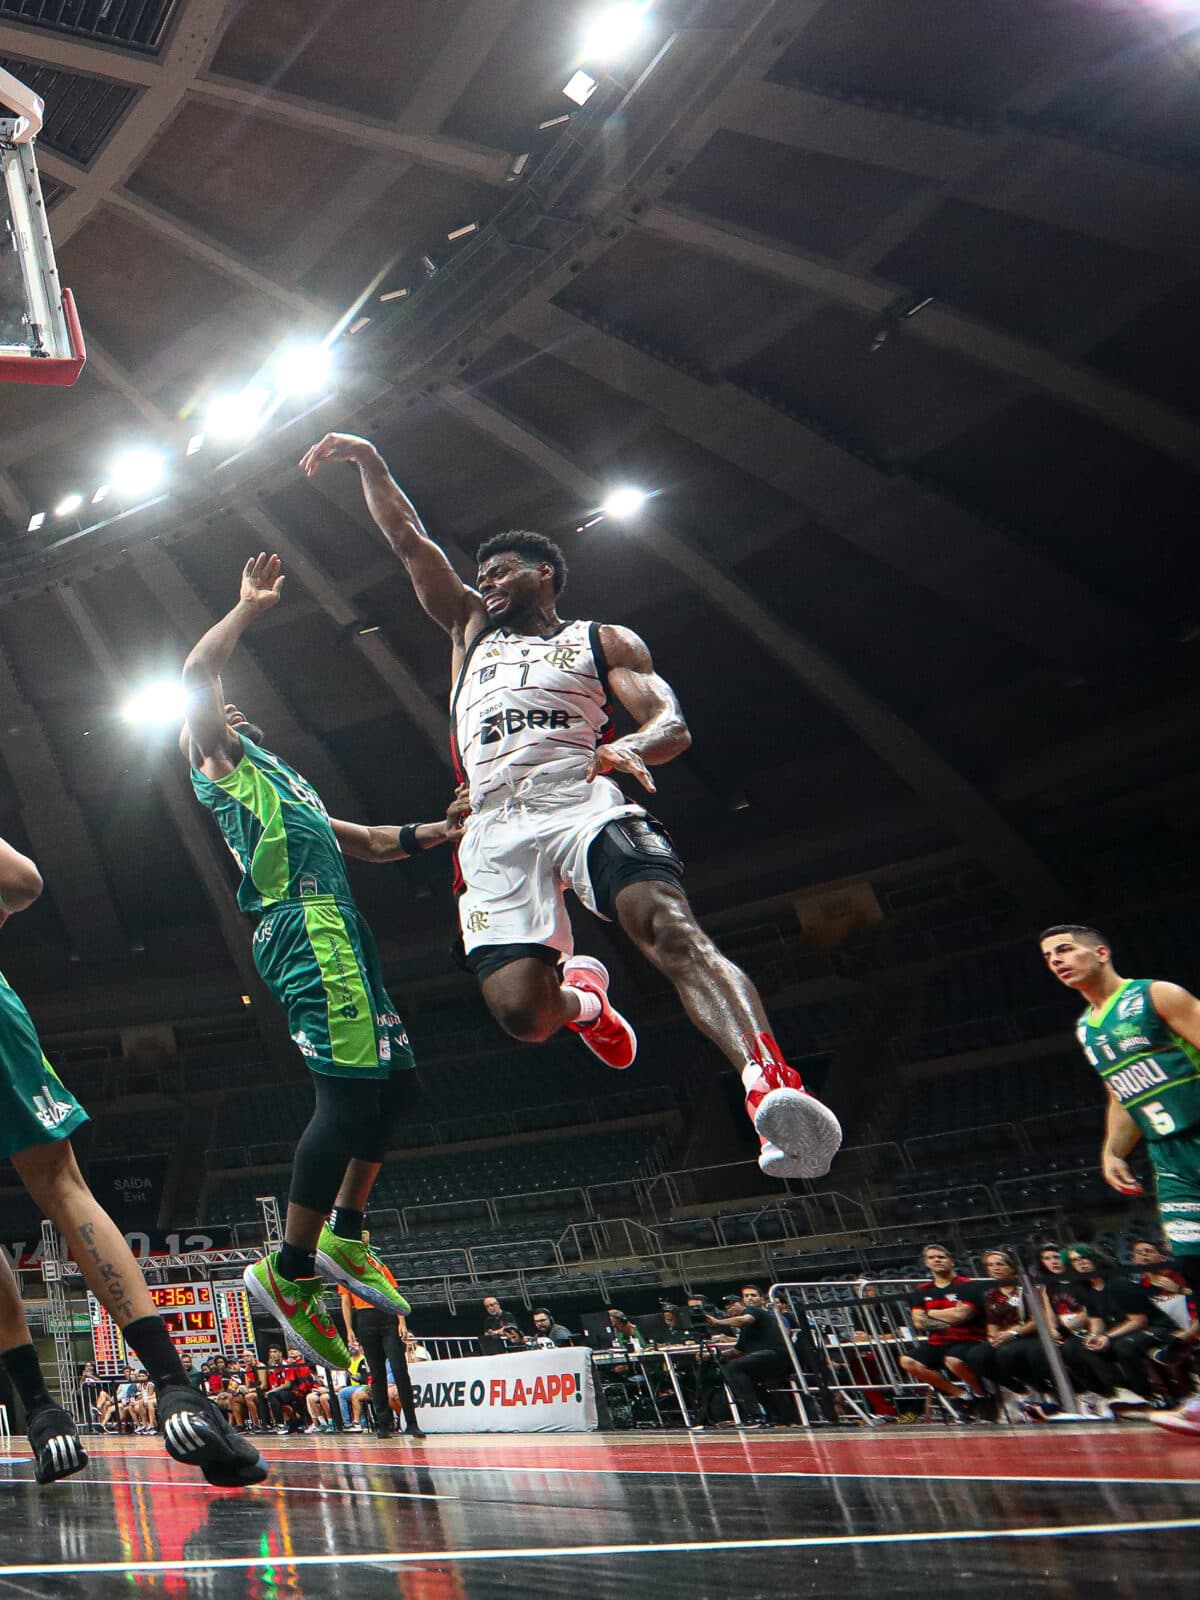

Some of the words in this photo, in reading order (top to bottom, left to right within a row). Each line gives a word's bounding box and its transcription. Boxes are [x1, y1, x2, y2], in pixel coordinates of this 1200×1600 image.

[519, 662, 530, 687] 7
[1106, 1058, 1169, 1102] AURU
[1141, 1102, 1176, 1136] 5
[113, 1175, 153, 1190] SAÍDA
[191, 1312, 214, 1329] 41
[410, 1380, 466, 1409] BAIXE
[469, 1379, 486, 1407] O
[489, 1372, 583, 1408] FLA-APP!
